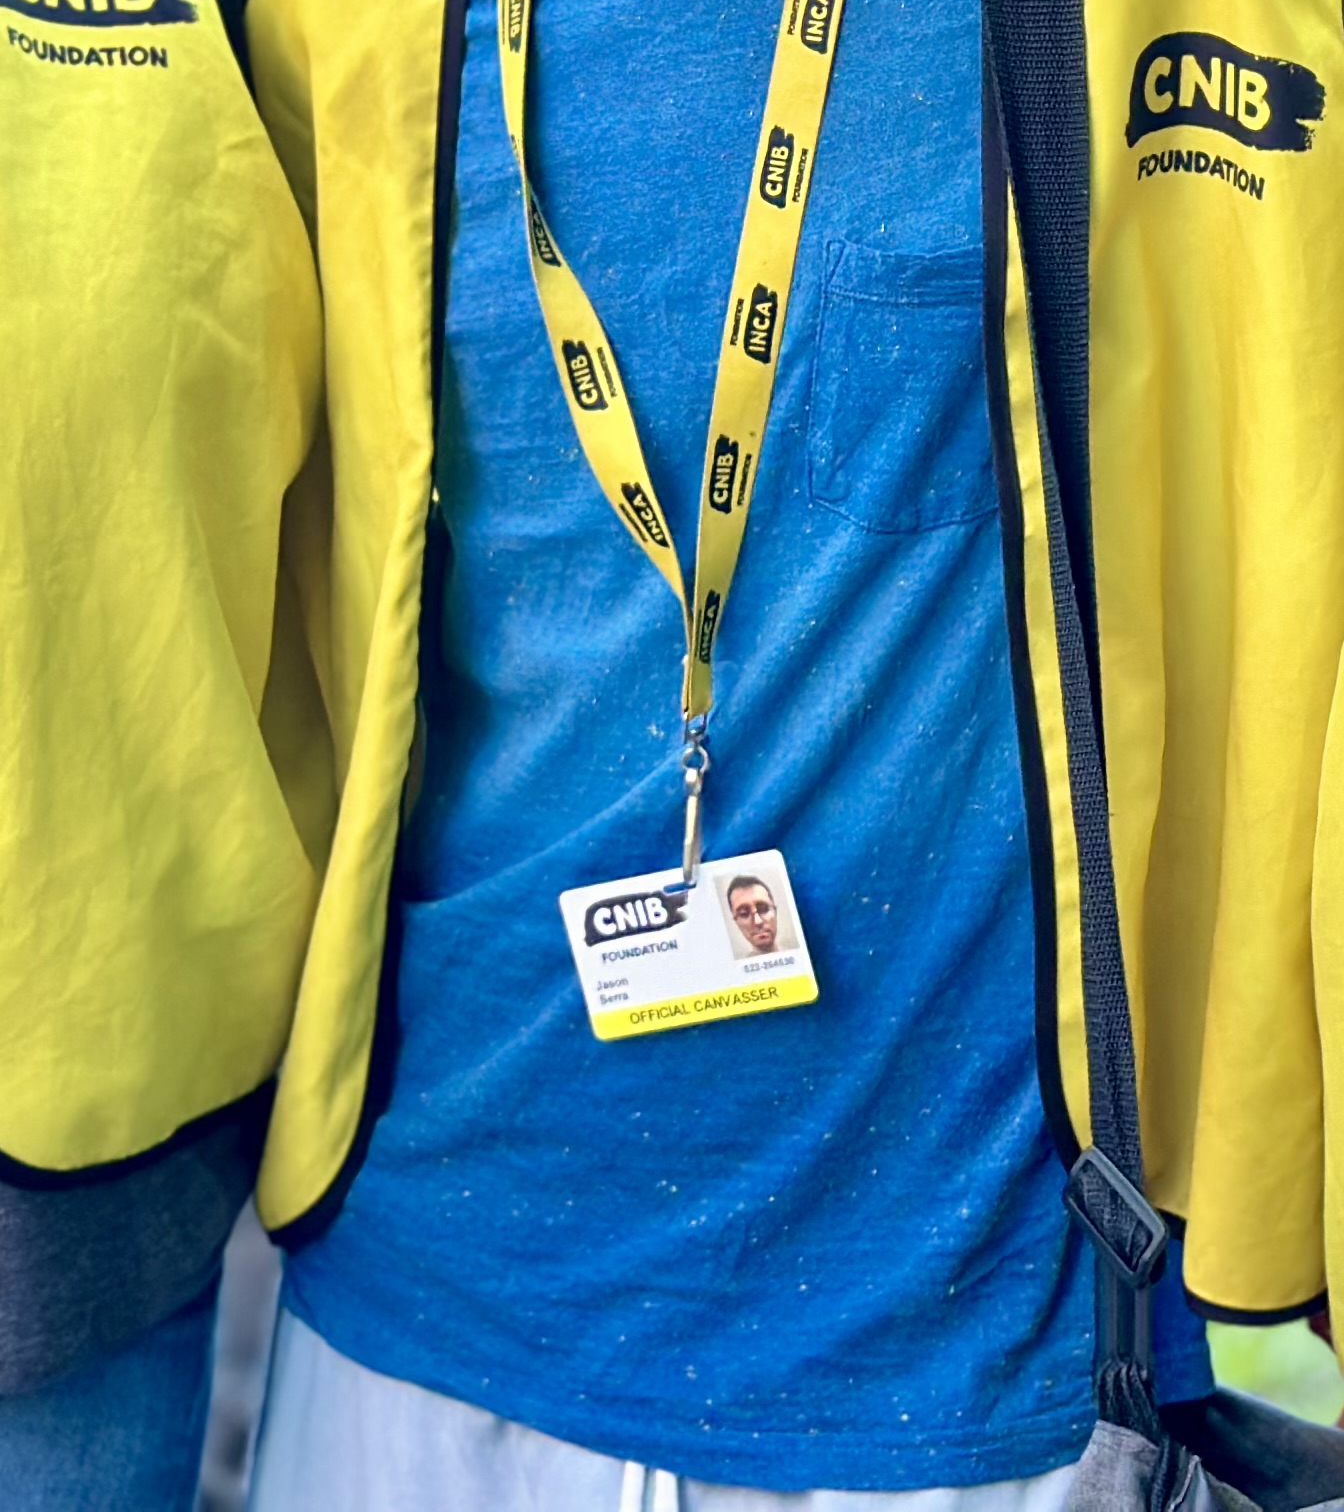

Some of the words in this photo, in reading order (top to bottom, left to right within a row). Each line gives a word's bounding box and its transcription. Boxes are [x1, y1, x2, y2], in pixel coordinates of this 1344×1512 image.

[7, 26, 169, 68] FOUNDATION
[1144, 55, 1270, 131] CNIB
[766, 145, 789, 196] CNIB
[1137, 149, 1265, 201] FOUNDATION
[749, 302, 773, 353] INCA
[570, 354, 600, 406] CNIB
[713, 454, 734, 505] CNIB
[632, 493, 664, 541] INCA
[593, 897, 668, 935] CNIB
[601, 939, 678, 964] FOUNDATION
[629, 1003, 690, 1025] OFFICIAL
[693, 986, 779, 1013] CANVASSER
